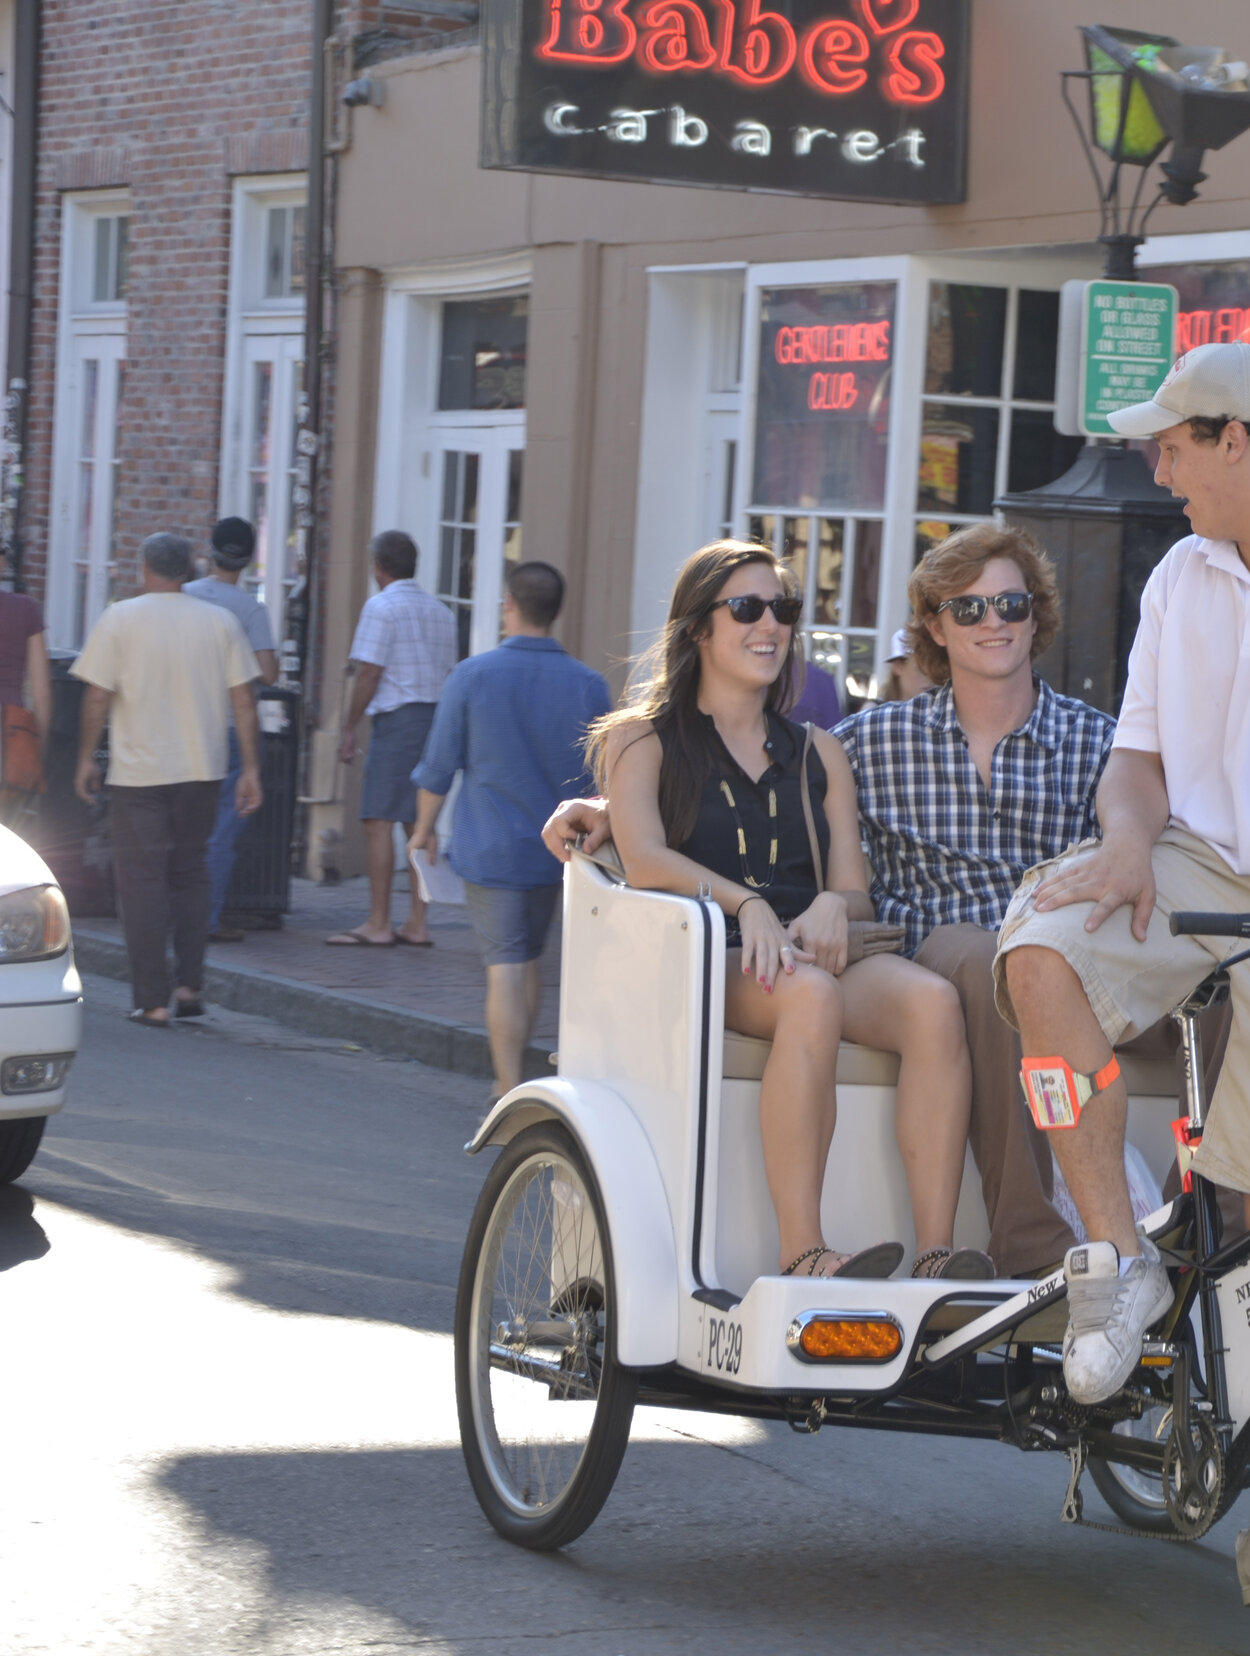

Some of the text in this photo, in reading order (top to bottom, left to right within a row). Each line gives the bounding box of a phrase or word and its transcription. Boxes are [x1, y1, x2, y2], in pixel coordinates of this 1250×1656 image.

[544, 104, 926, 168] cabaret
[1121, 311, 1161, 326] GLASS
[1102, 325, 1158, 341] ALLOWED
[1118, 341, 1162, 355] STREET
[808, 372, 859, 410] CLUB
[1027, 1278, 1058, 1306] New
[708, 1317, 743, 1375] PC-29
